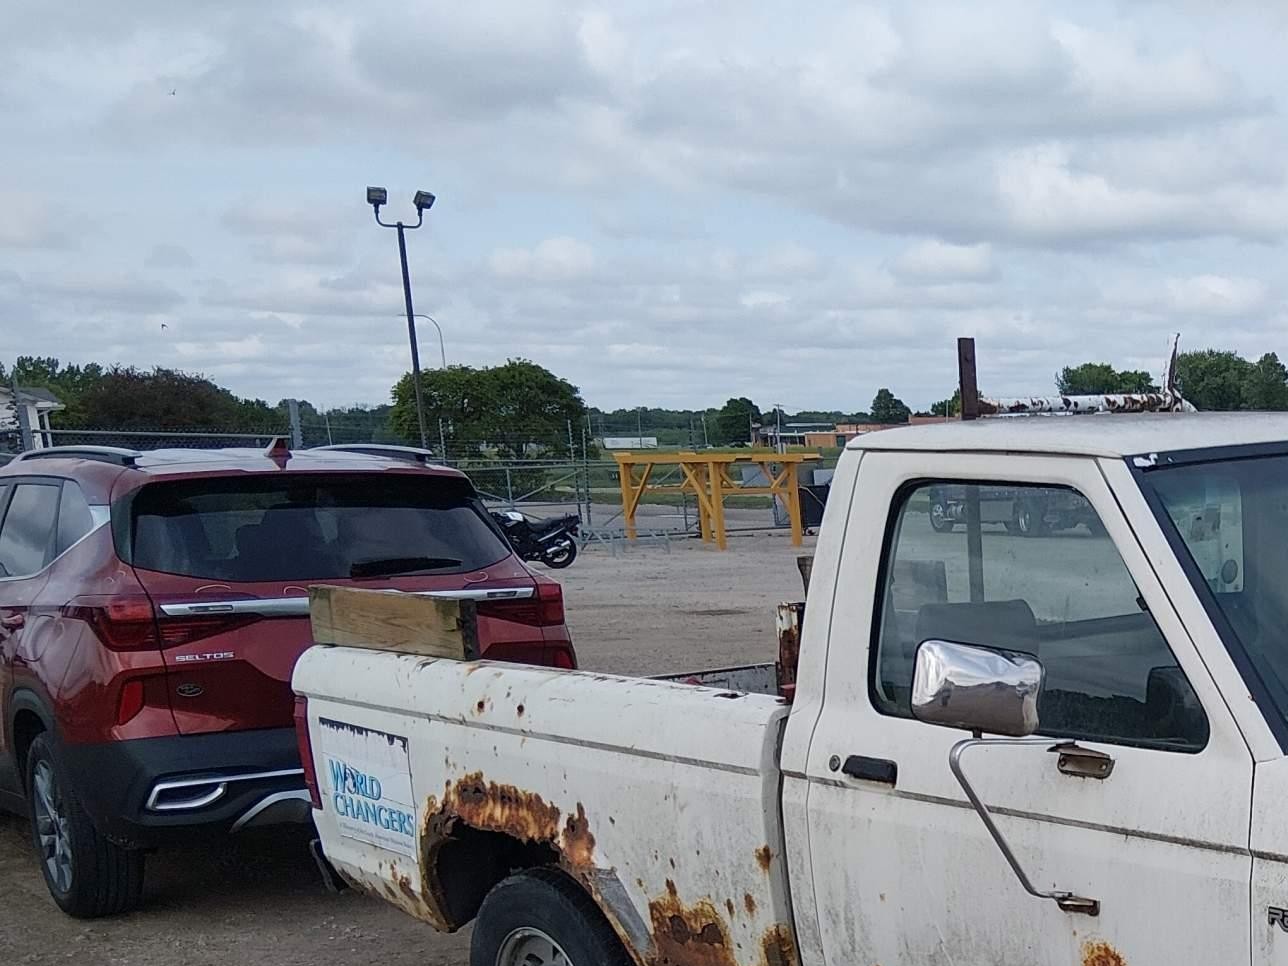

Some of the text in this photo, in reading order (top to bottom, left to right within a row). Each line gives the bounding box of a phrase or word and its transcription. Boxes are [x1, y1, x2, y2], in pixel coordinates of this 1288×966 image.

[175, 651, 235, 663] SELTOS
[328, 758, 383, 801] WORLD
[334, 791, 415, 838] CHANGERS
